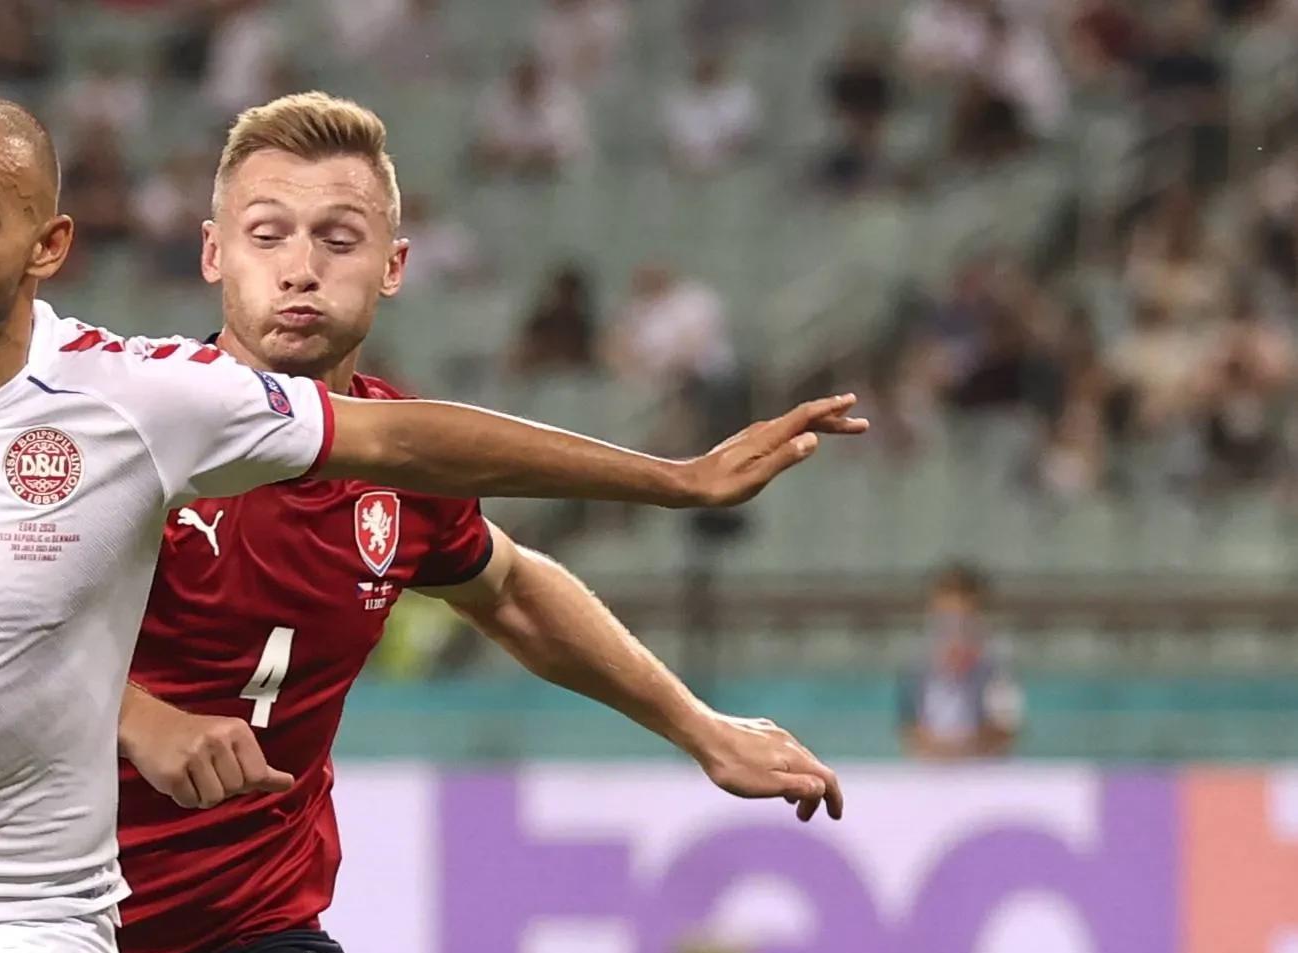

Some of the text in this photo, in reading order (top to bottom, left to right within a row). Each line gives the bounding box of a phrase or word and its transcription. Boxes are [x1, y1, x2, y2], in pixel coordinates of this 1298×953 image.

[5, 449, 25, 497] DANSK
[62, 453, 82, 497] UNION
[20, 453, 67, 477] DBU
[27, 494, 60, 505] 1889
[239, 626, 295, 728] 4
